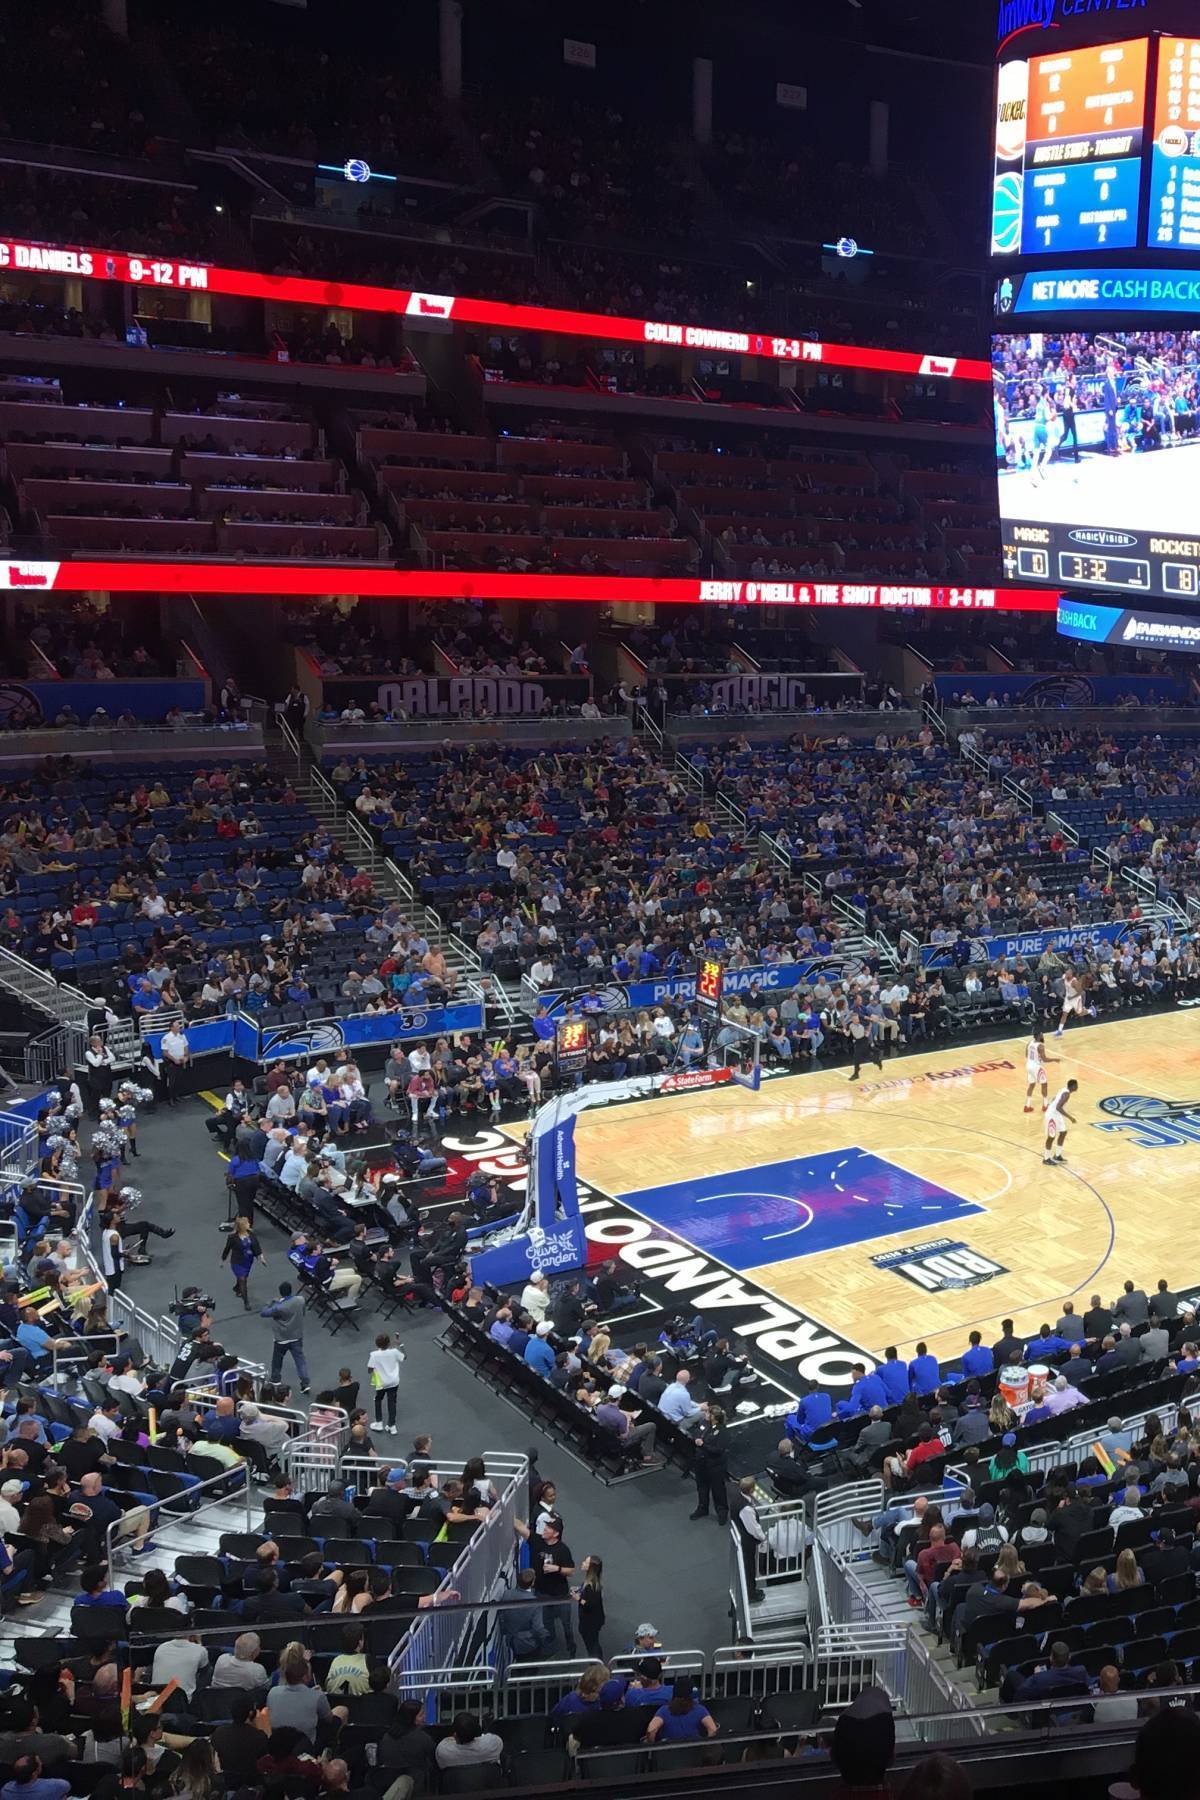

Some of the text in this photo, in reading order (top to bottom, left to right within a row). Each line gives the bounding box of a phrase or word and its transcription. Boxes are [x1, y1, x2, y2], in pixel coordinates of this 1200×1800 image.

[15, 246, 93, 274] DANIELS
[129, 259, 208, 288] 9-12 PM
[1032, 279, 1200, 300] NET MORE CASH BACK
[772, 338, 799, 358] 12-3
[1014, 527, 1049, 543] MAGIC
[1032, 554, 1043, 573] 10
[1073, 557, 1107, 581] 3:32
[1179, 570, 1191, 591] 18
[699, 582, 742, 601] JERRY
[799, 589, 810, 603] &
[814, 585, 840, 603] THE
[842, 586, 877, 605] SHOT
[880, 587, 931, 605] DOCTOR
[950, 590, 995, 607] 3-6 PM
[1072, 612, 1097, 631] BACK
[378, 677, 543, 713] ORLANDO
[711, 677, 806, 712] MAGIC
[1007, 930, 1100, 955] PURE MAGIC
[701, 975, 716, 997] 22
[723, 970, 779, 991] MAGIC
[926, 1060, 1016, 1082] Amway
[556, 1130, 564, 1180] AdventHealth
[526, 1245, 559, 1259] Olive
[532, 1251, 578, 1270] Garden
[900, 1249, 1002, 1289] RDV
[584, 1218, 876, 1386] ORLANDO
